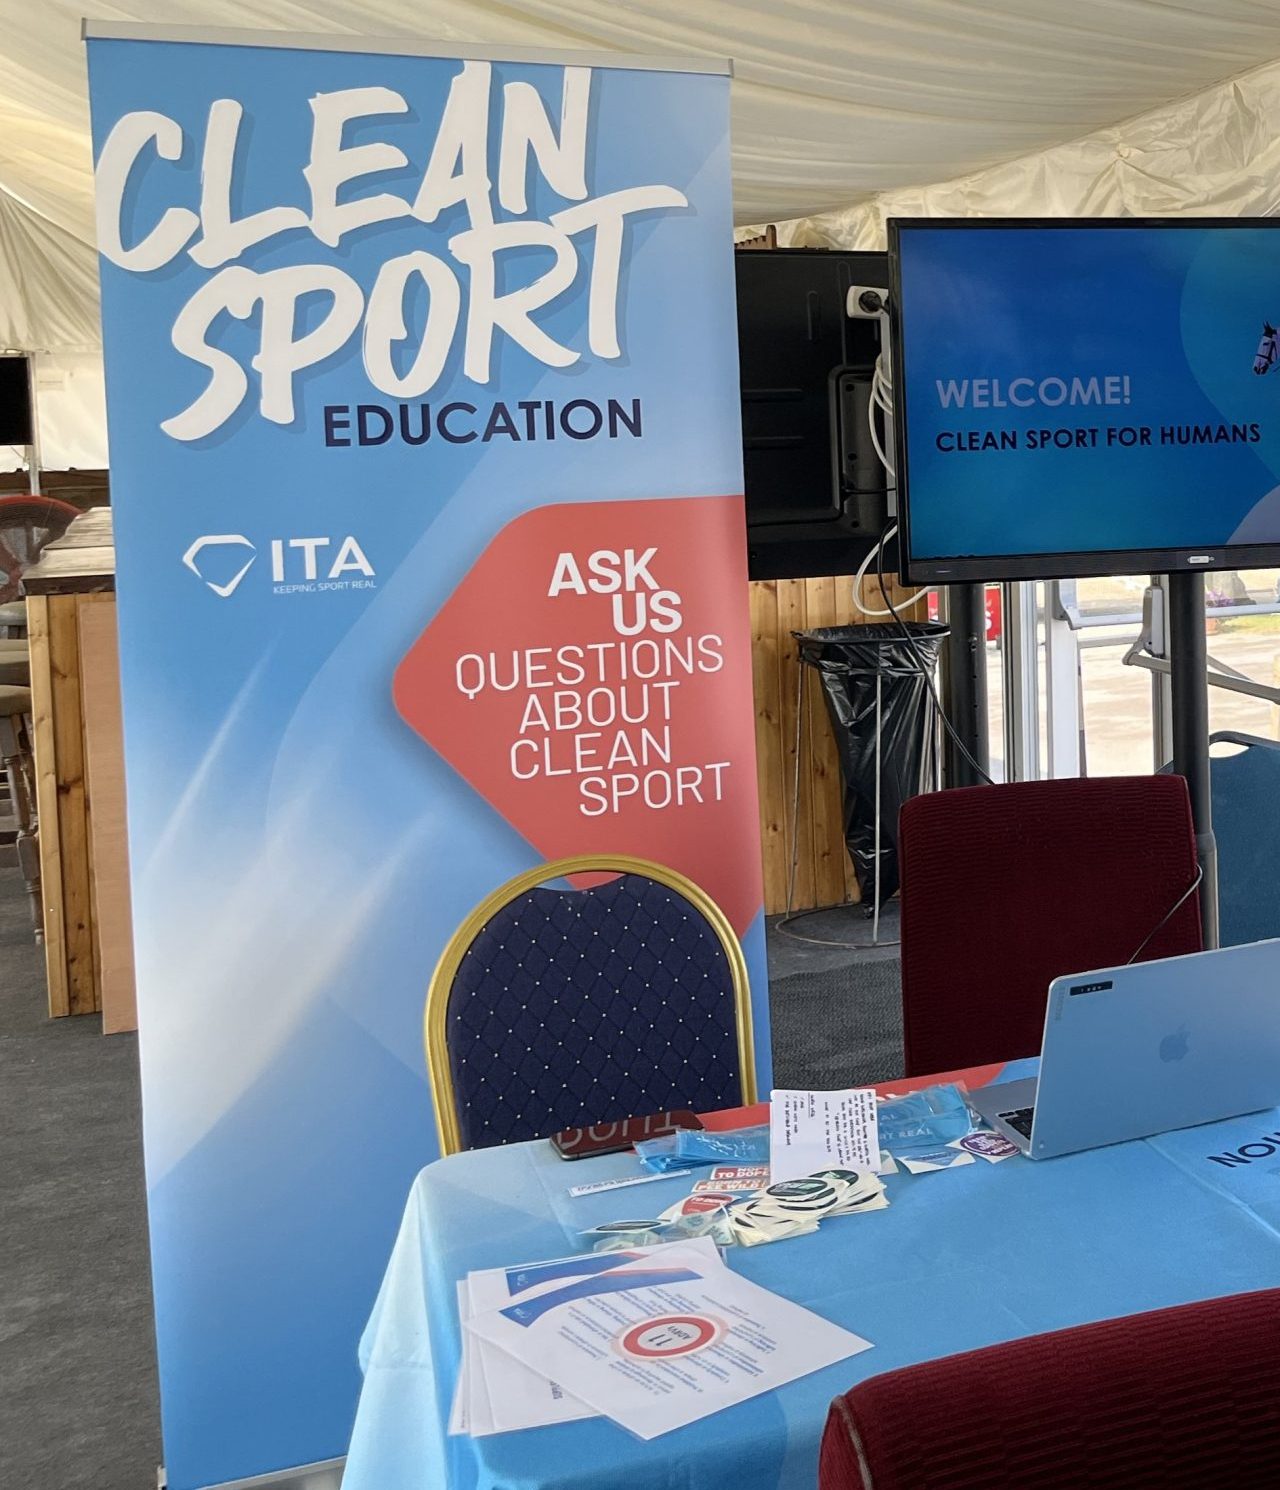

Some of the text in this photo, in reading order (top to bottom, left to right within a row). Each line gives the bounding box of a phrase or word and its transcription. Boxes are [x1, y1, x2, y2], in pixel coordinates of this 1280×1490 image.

[95, 60, 592, 271] CLEAN
[160, 185, 688, 441] SPORT
[936, 375, 1131, 409] WELCOME!
[323, 398, 643, 447] EDUCATION
[935, 423, 1261, 452] CLEAN SPORT FOR HUMANS
[271, 535, 377, 582] ITA
[547, 547, 661, 597] ASK
[273, 580, 377, 594] KEEPING SPORT REAL
[611, 590, 683, 636] US
[455, 634, 724, 701] QUESTIONS
[518, 681, 681, 734] ABOUT
[509, 726, 672, 780] CLEAN
[578, 761, 731, 817] SPORT
